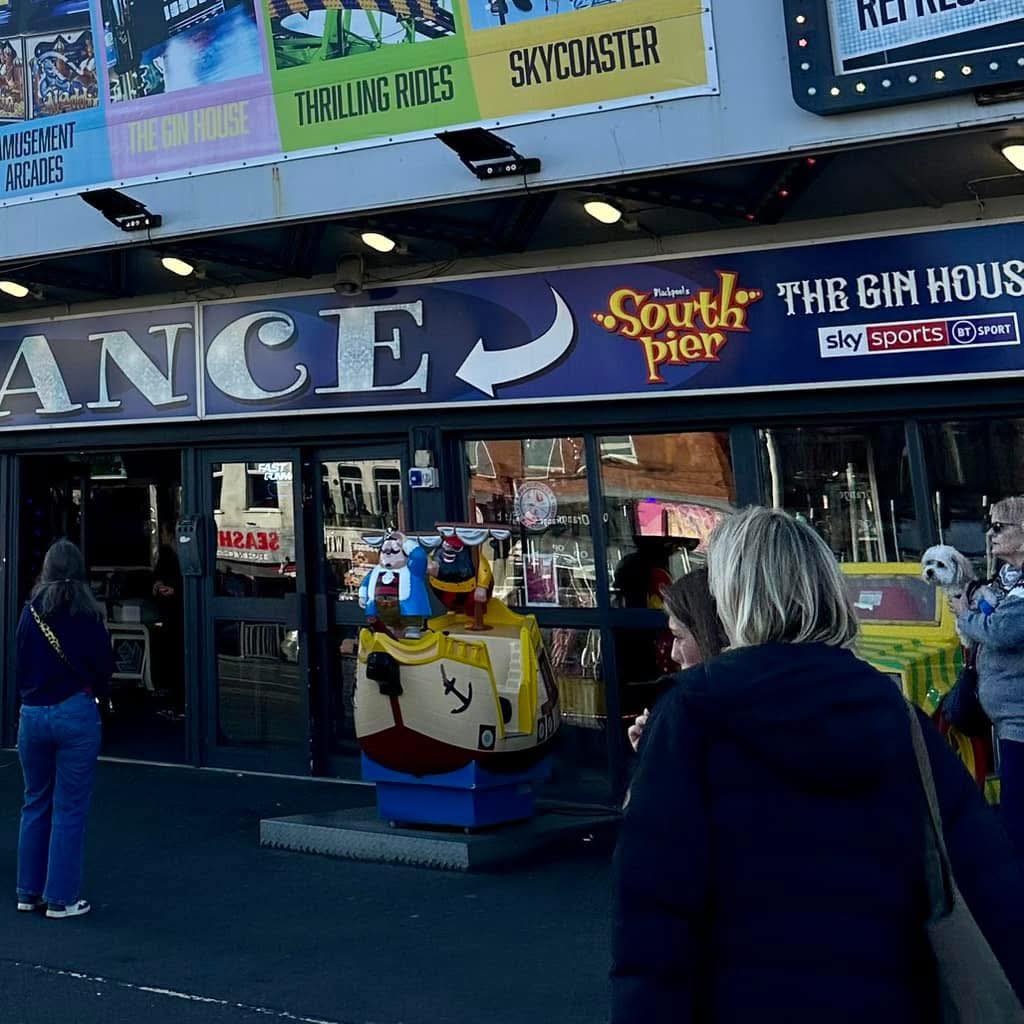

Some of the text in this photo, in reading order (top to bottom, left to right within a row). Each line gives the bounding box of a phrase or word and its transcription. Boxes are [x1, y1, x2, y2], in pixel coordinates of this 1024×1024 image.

[509, 25, 660, 89] SKYCOASTER
[294, 65, 455, 127] THRILLING RIDES
[128, 101, 250, 154] THE GIN HOUSE
[5, 156, 64, 193] ARCADES
[608, 270, 748, 337] South
[777, 259, 1024, 316] THE GIN HOUS
[640, 329, 726, 383] pier
[826, 323, 1011, 352] sky sports BT SPORT
[258, 463, 285, 473] FAST
